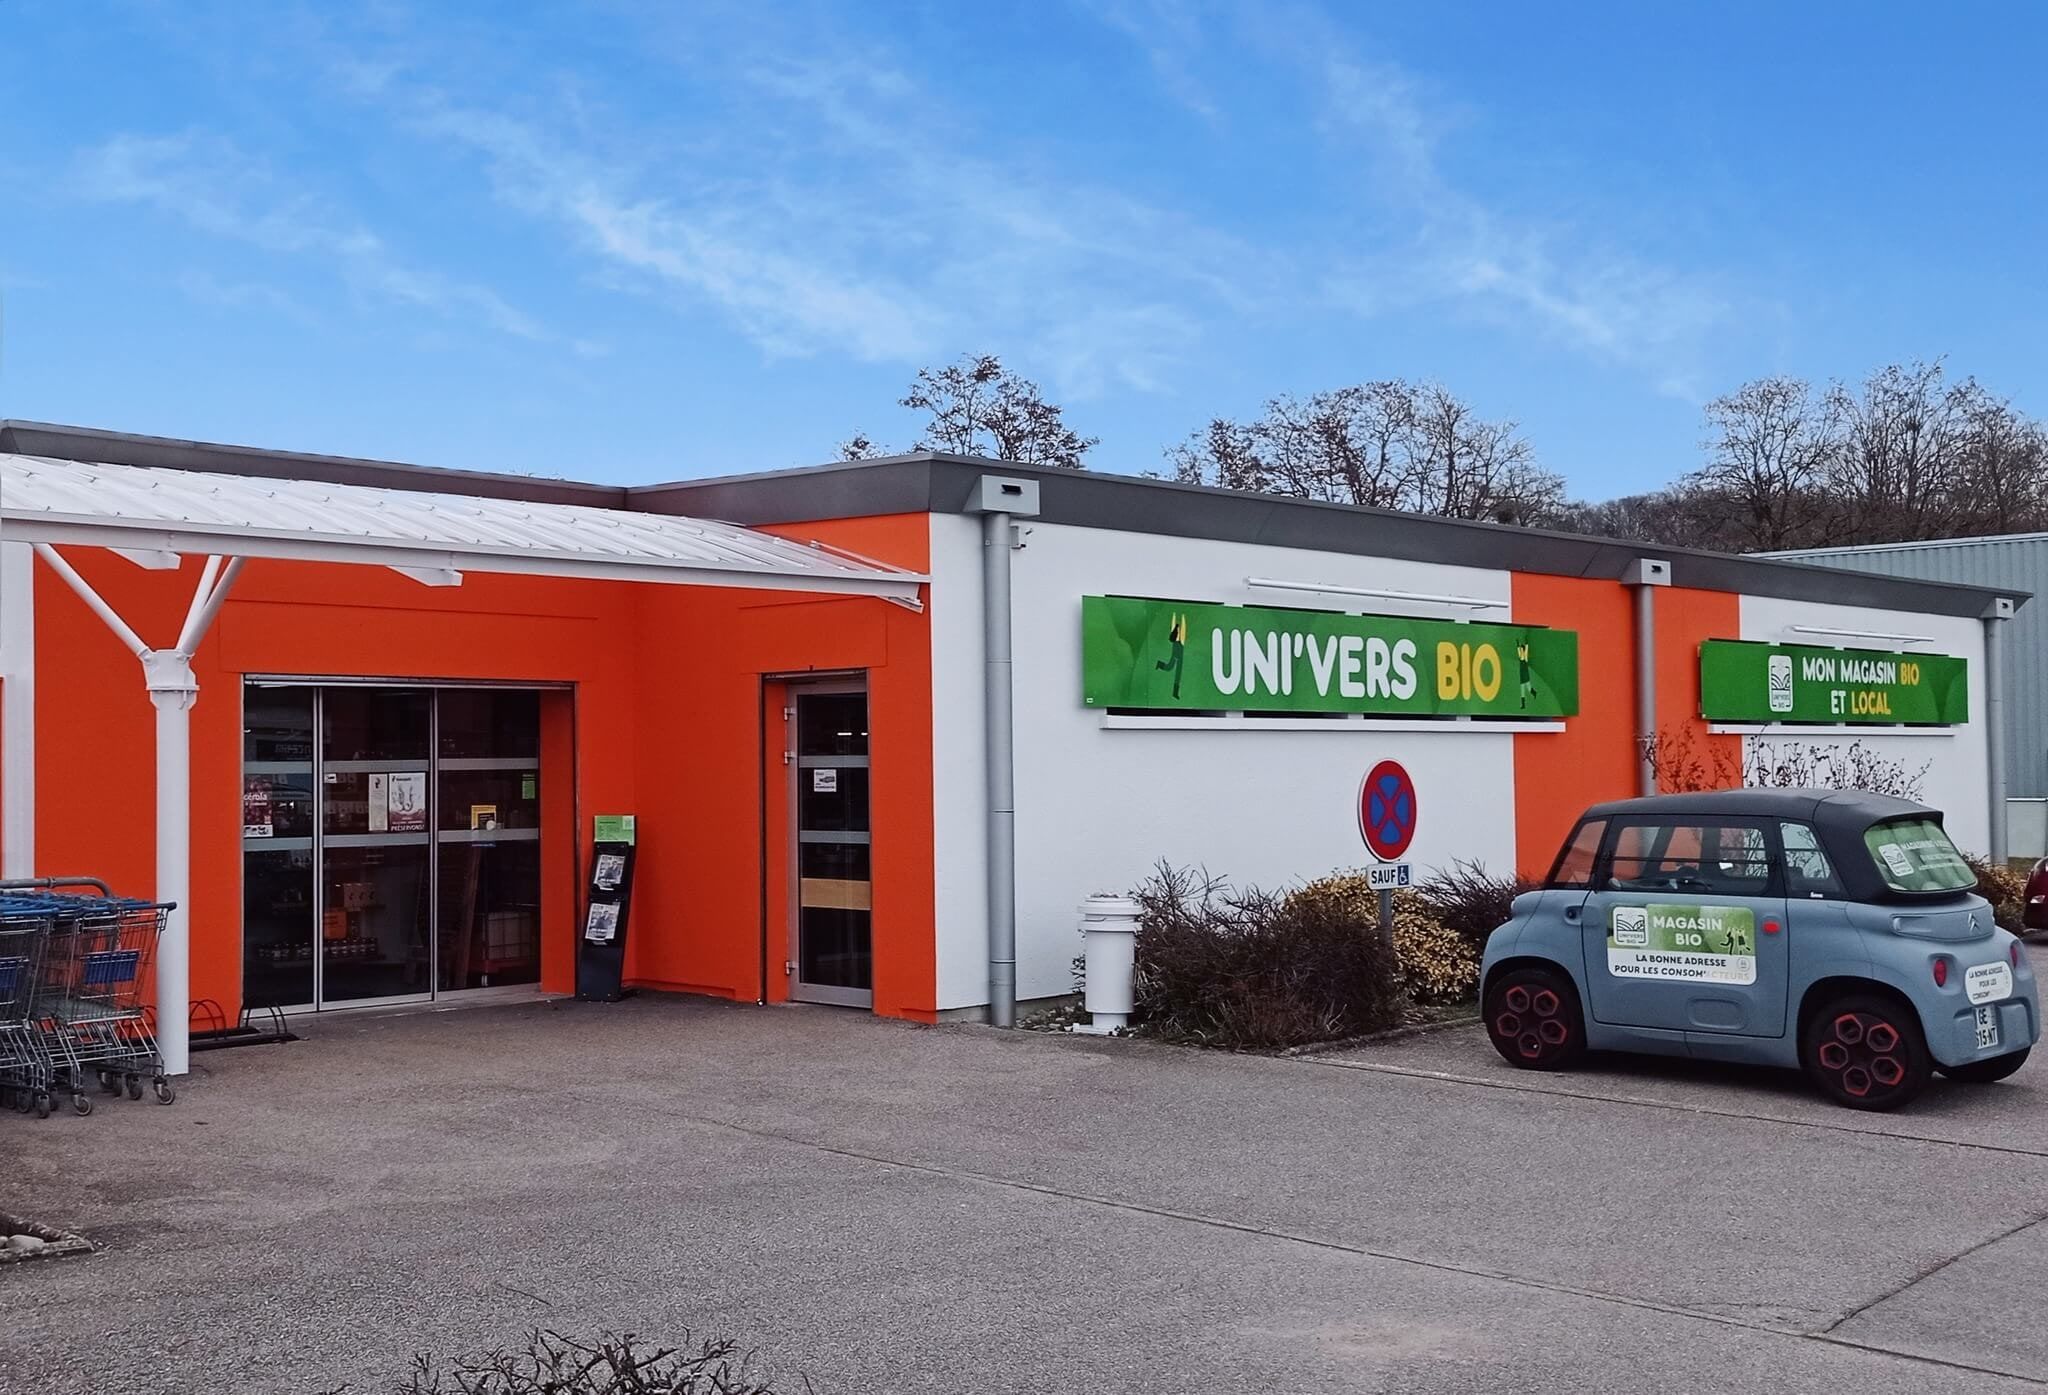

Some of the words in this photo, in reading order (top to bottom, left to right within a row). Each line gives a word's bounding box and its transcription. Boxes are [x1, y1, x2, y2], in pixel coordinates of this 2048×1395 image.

[1211, 627, 1417, 700] UNI'VERS
[1437, 641, 1502, 702] BIO
[1802, 656, 1836, 682] MON
[1840, 659, 1896, 685] MAGASIN
[1900, 663, 1920, 687] BIO
[1831, 690, 1846, 714] ET
[1851, 691, 1892, 715] LOCAL
[1372, 870, 1395, 884] SAUF
[1653, 916, 1723, 931] MAGASIN
[1675, 933, 1703, 946] BIO
[1636, 954, 1647, 962] LA
[1650, 955, 1682, 964] BONNE
[1684, 957, 1727, 967] ADRESSE
[1614, 965, 1640, 974] POUR
[1643, 967, 1659, 975] LES
